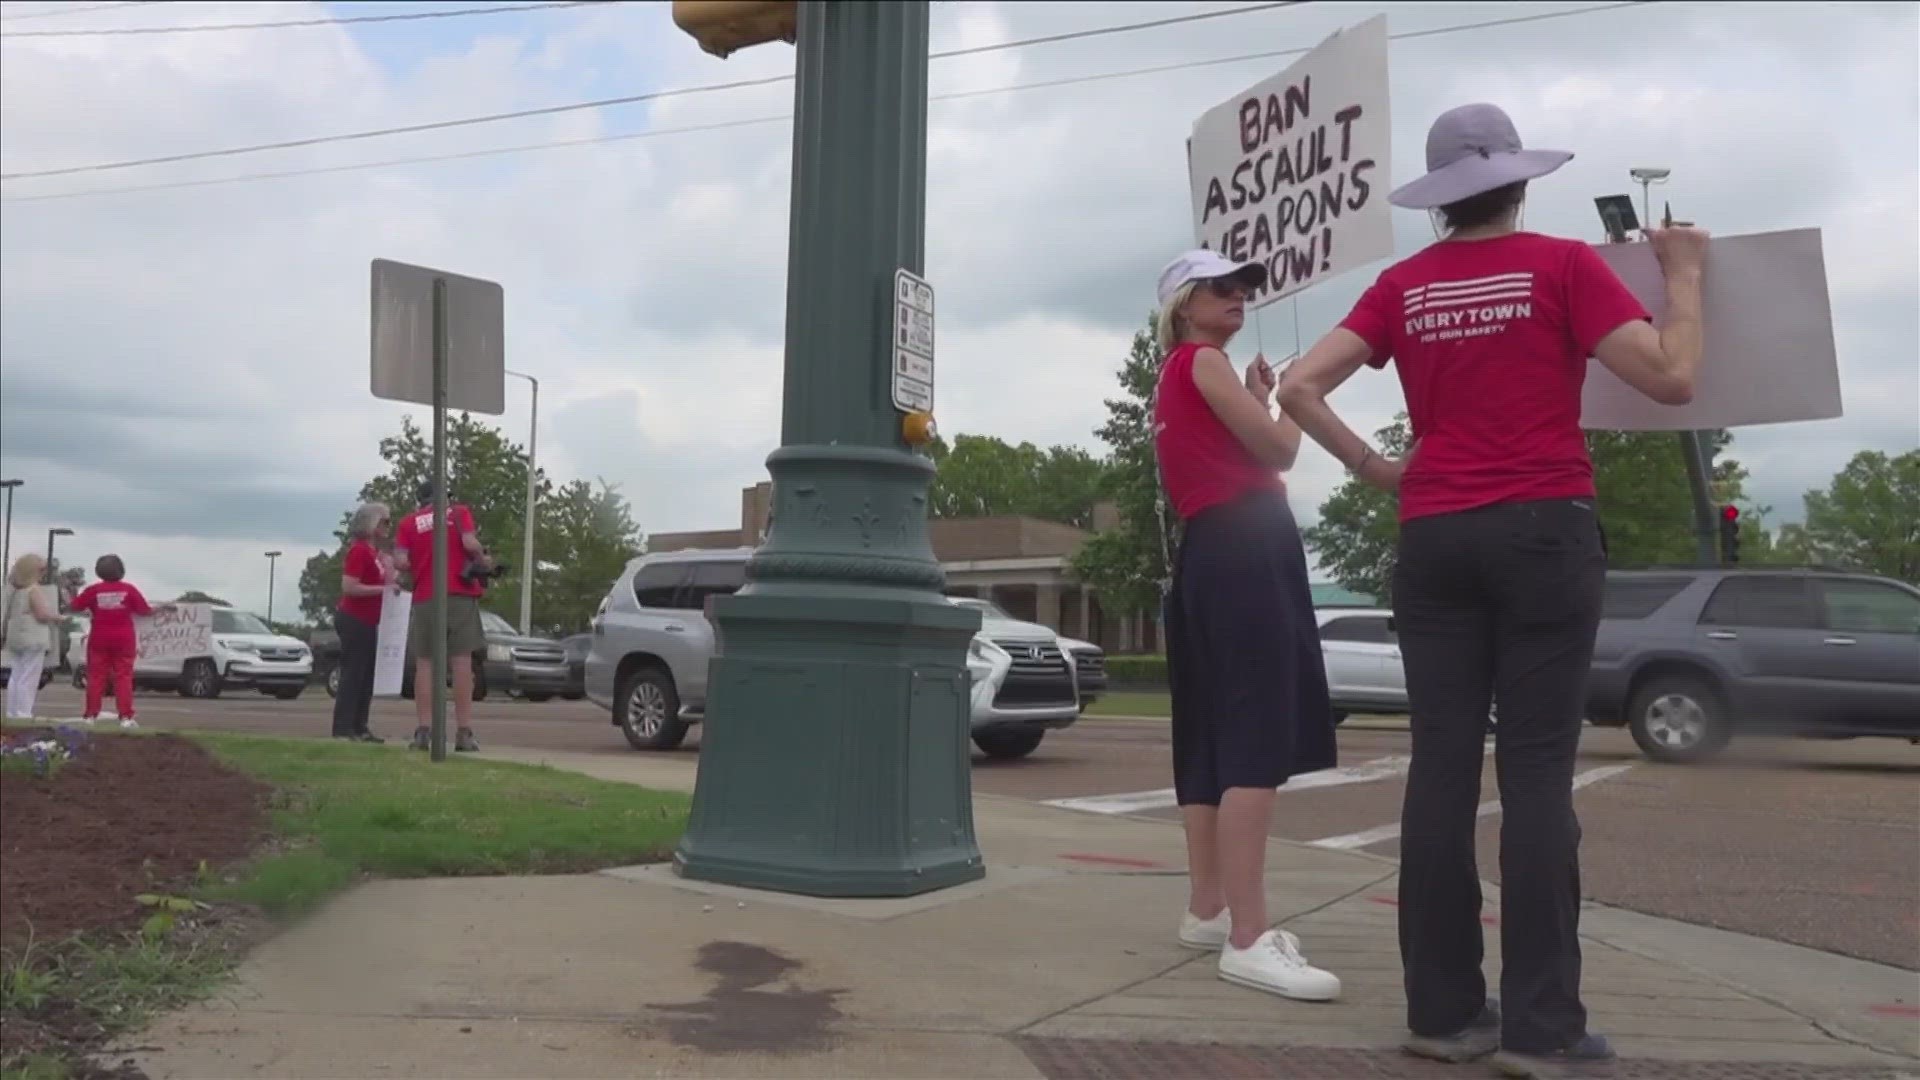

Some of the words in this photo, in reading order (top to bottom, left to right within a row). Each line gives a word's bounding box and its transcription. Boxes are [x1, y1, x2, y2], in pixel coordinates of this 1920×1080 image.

[1239, 74, 1310, 154] BAN
[1202, 104, 1363, 224] ASSAULT
[1405, 303, 1532, 336] EVERYTOWN
[1439, 328, 1463, 340] GUN
[1464, 324, 1507, 338] SAFETY
